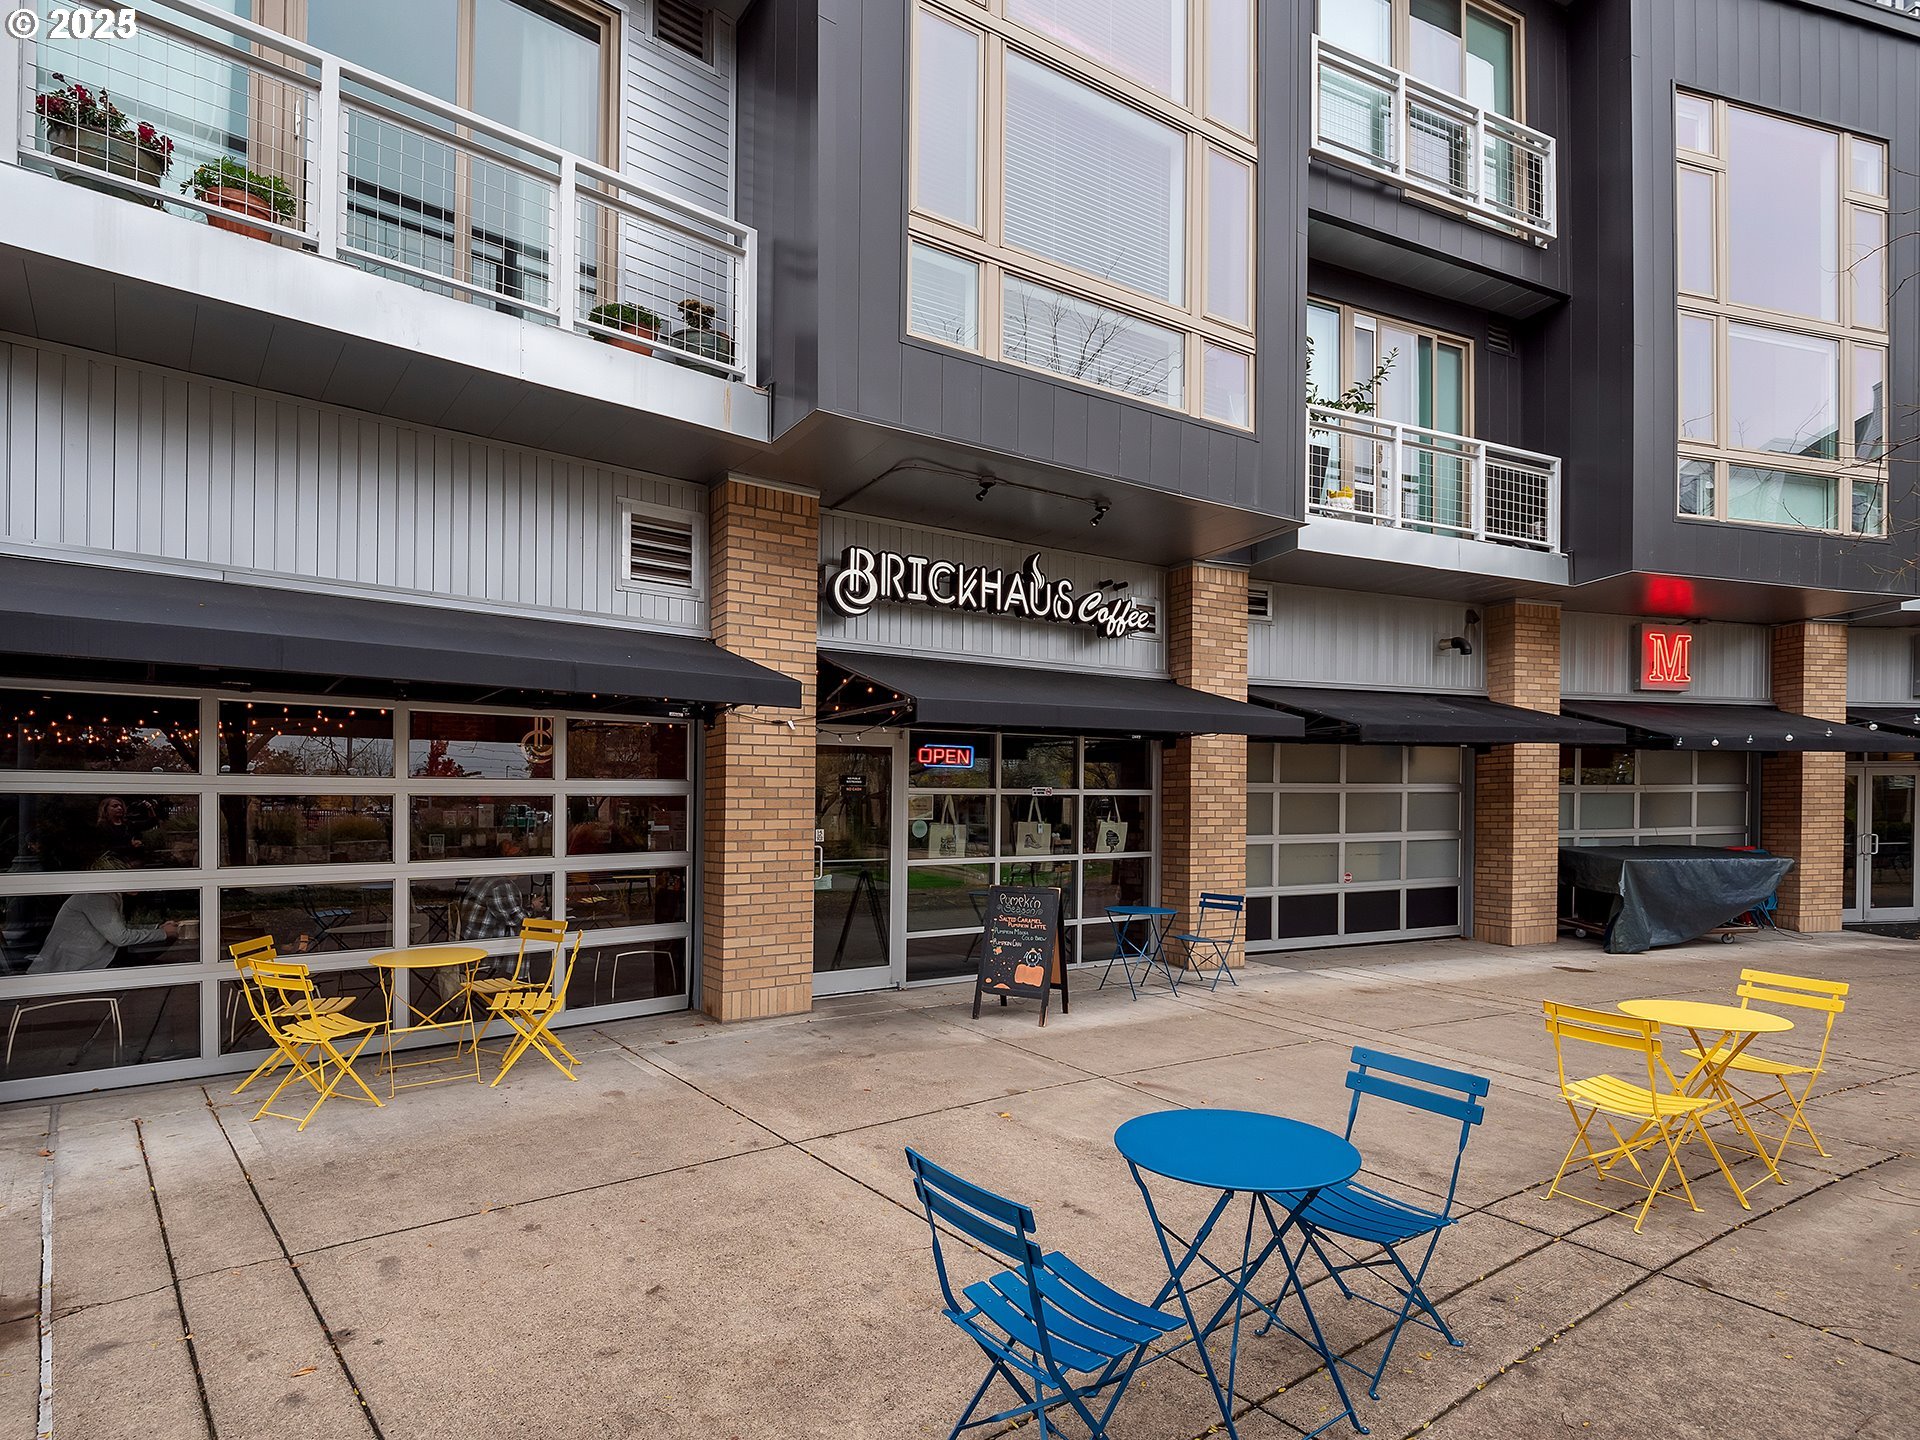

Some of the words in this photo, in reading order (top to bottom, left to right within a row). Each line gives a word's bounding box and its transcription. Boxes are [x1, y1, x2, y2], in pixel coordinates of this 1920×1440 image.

[831, 546, 1074, 619] BRICKHAUS
[1077, 590, 1151, 638] Coffee
[1649, 633, 1692, 682] M
[918, 748, 970, 765] OPEN
[1017, 916, 1042, 925] CARAMEL
[1030, 923, 1047, 931] LATTE
